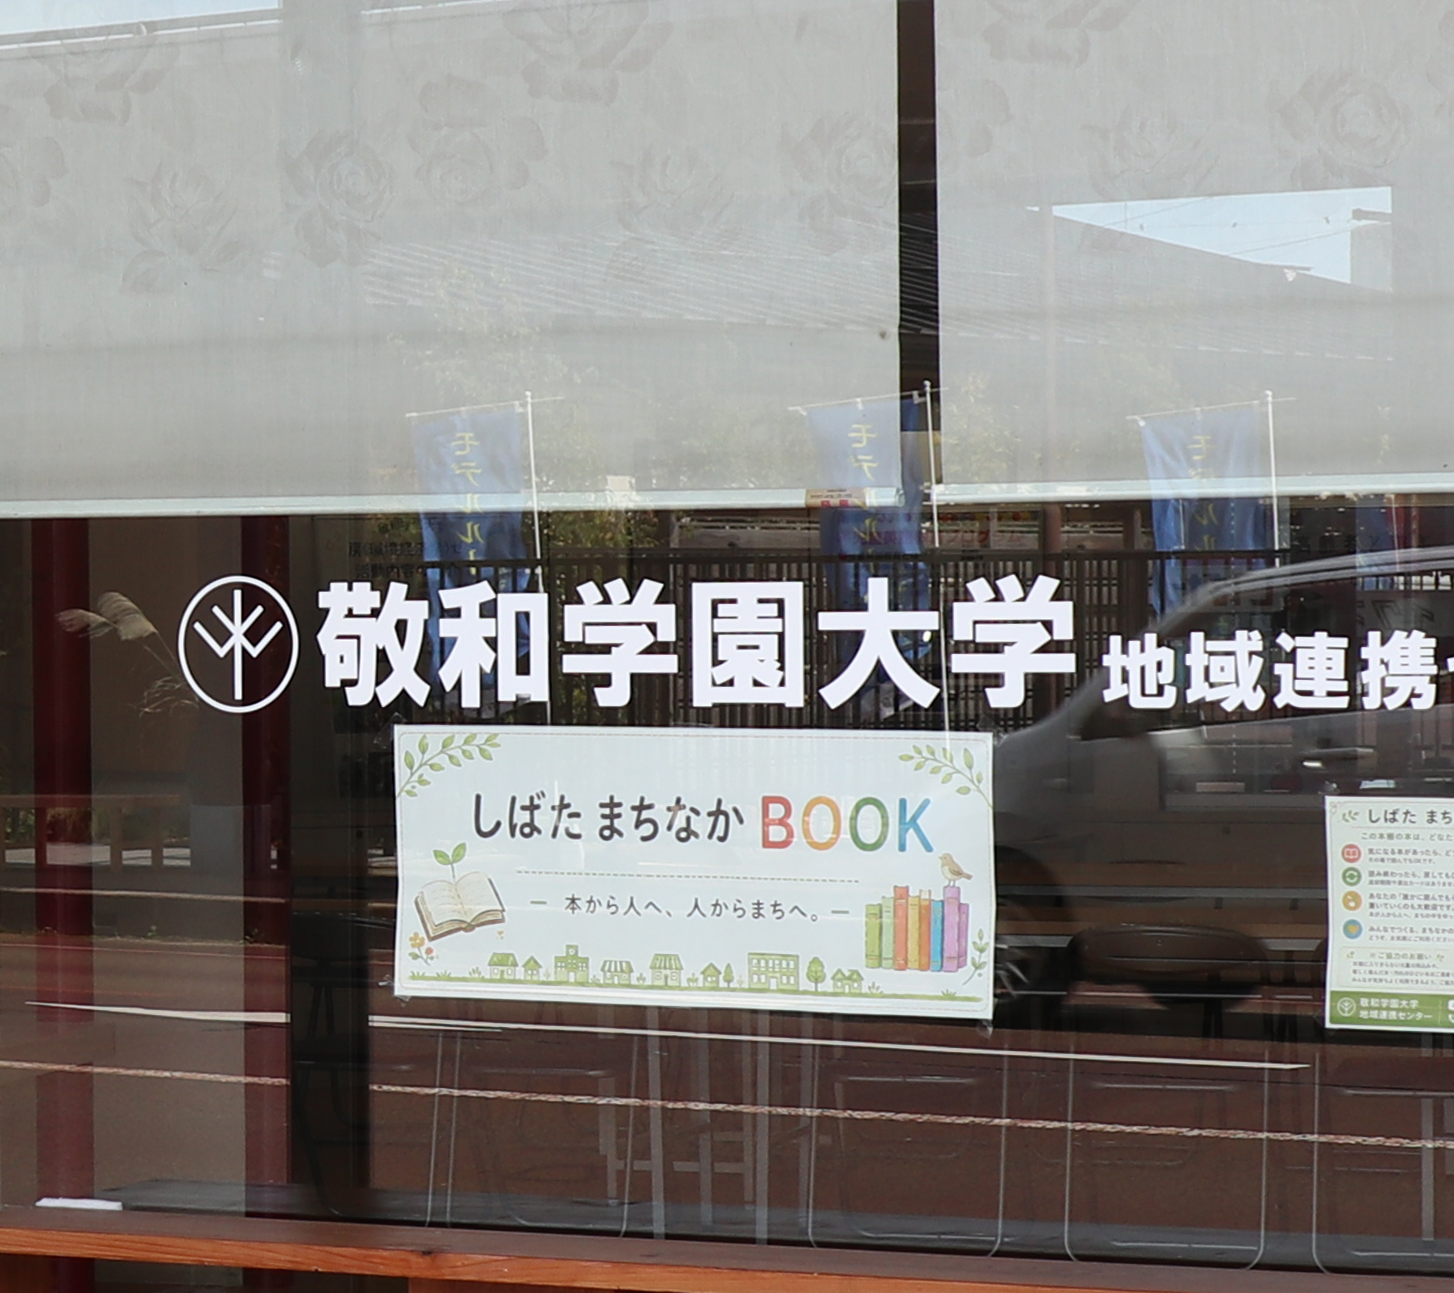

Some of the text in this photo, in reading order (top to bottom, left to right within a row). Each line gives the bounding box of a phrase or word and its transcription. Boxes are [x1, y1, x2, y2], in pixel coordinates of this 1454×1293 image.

[316, 574, 1076, 709] 敬和学園大学
[473, 791, 935, 853] しばた まちなか BOOK
[1367, 808, 1418, 825] しばた
[564, 894, 819, 922] 本から人へ、人からまちへ。
